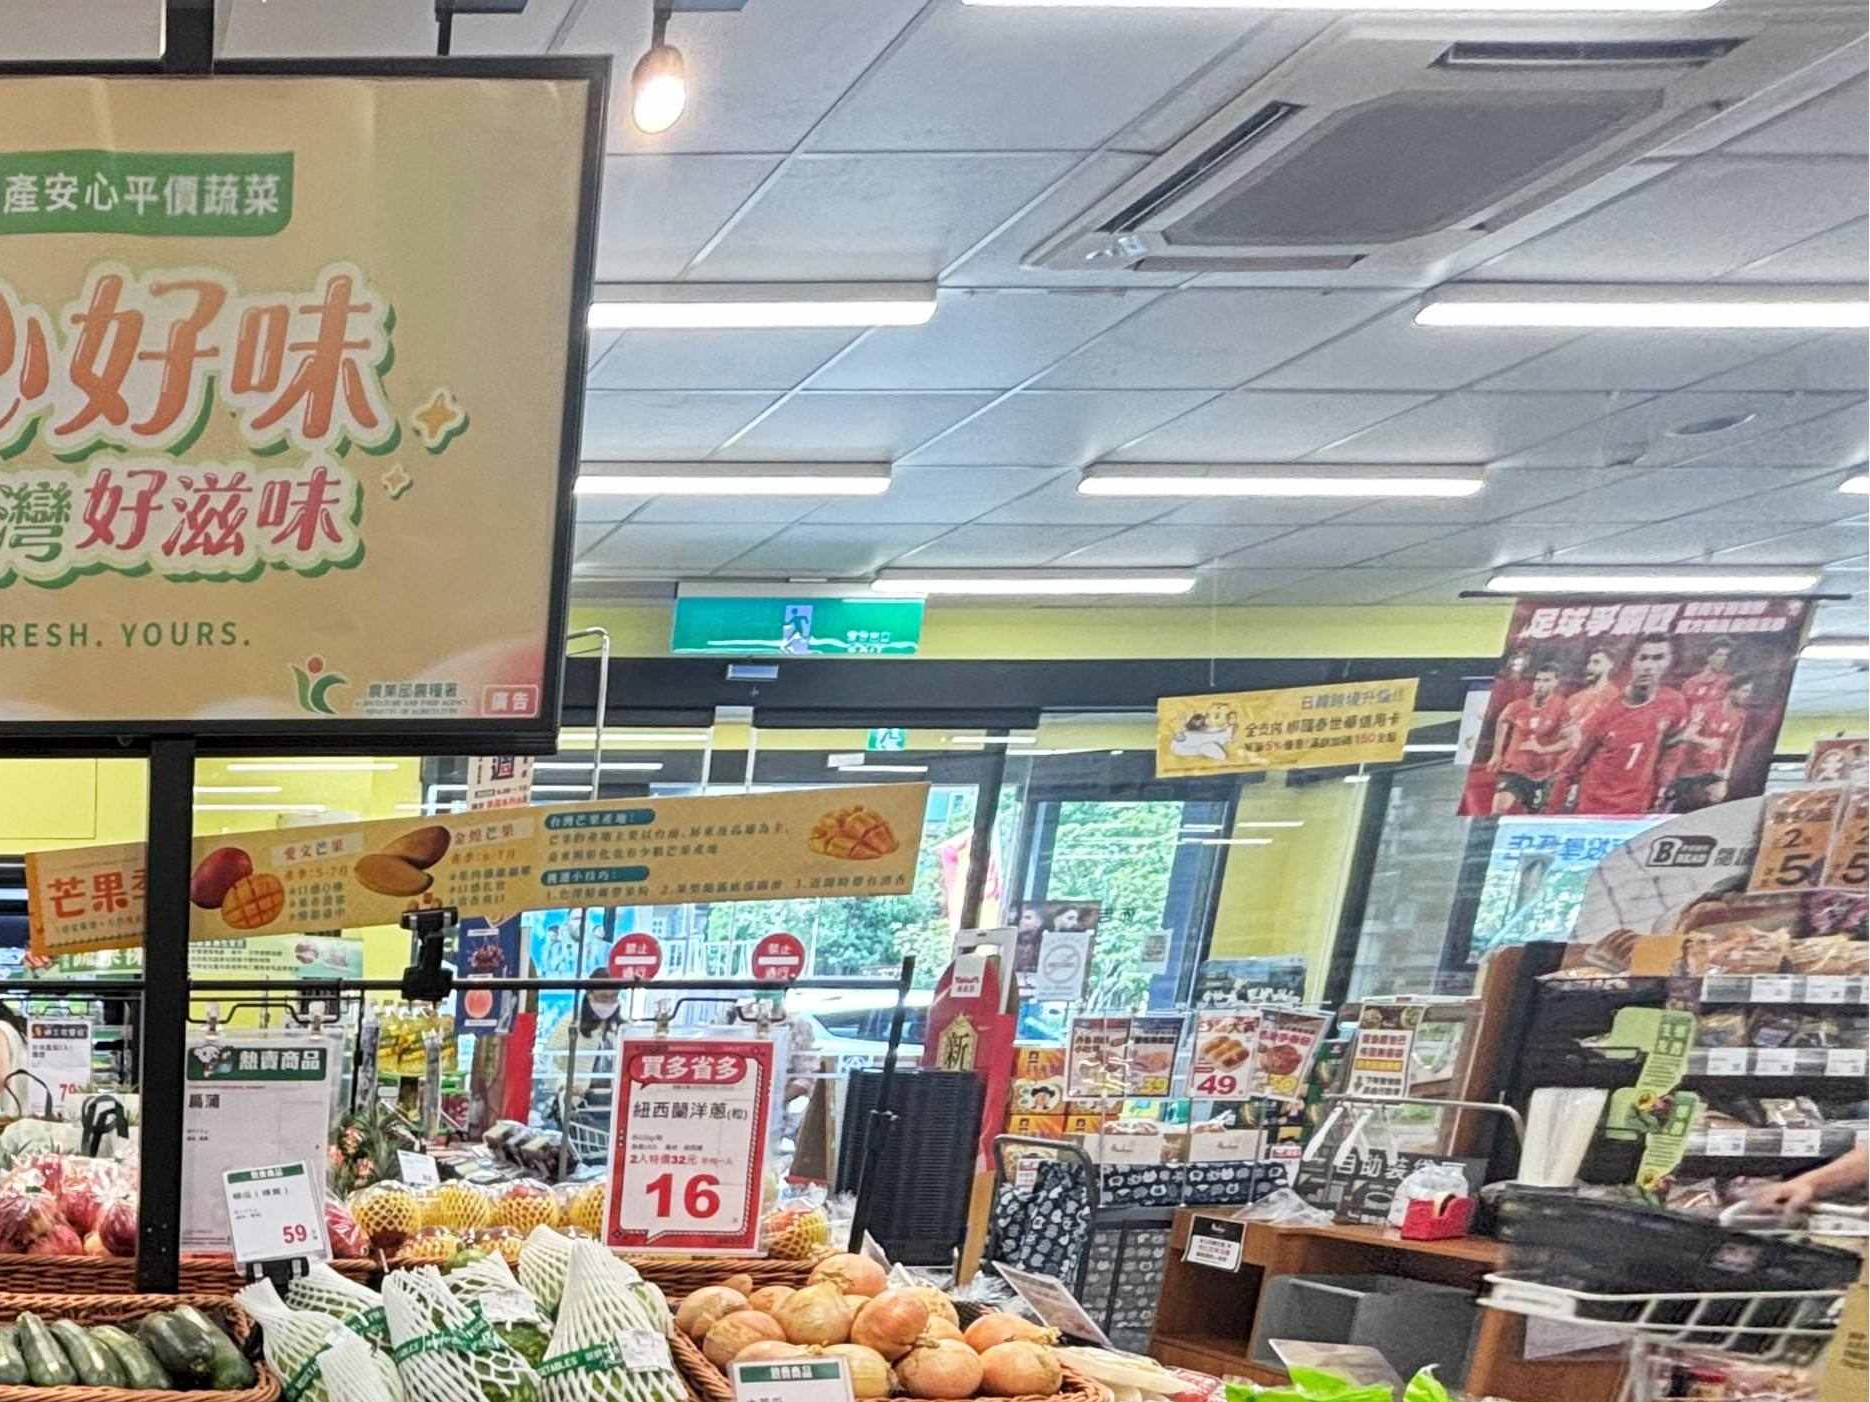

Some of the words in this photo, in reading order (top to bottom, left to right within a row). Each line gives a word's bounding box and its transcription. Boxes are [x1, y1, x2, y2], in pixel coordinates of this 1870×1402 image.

[122, 620, 252, 649] YOURS.
[489, 692, 529, 713] 廣告
[238, 1049, 321, 1071] 熱賣商品
[641, 1054, 741, 1081] 買多省多
[1196, 1074, 1238, 1096] 49
[644, 1171, 721, 1220] 16
[282, 1223, 308, 1245] 59
